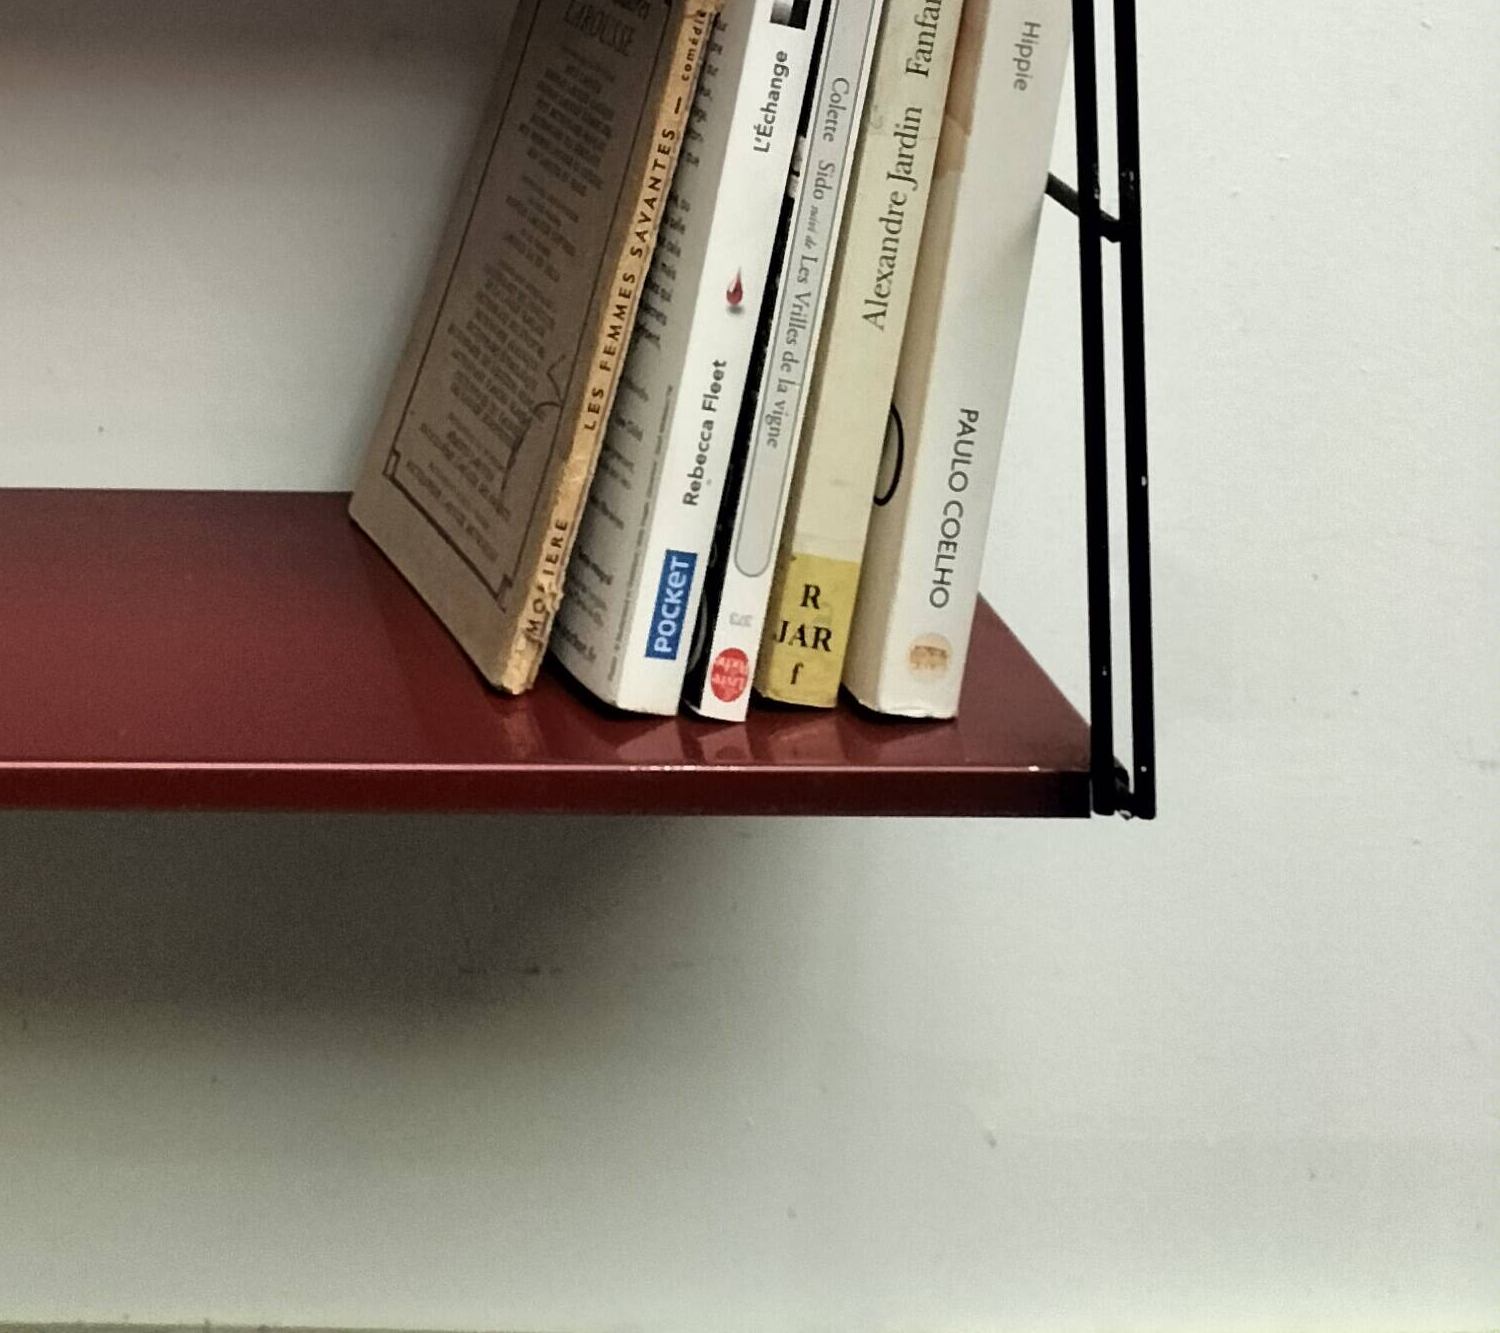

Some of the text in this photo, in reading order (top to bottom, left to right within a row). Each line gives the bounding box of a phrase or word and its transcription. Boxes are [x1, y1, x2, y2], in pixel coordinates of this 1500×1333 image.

[1012, 19, 1043, 92] Hippie
[752, 49, 791, 154] L'Échange
[822, 76, 851, 144] Colette
[812, 159, 837, 201] Sido
[861, 105, 924, 333] Alexandre Jardin
[583, 386, 605, 432] LES
[598, 271, 636, 373] FEMMES
[629, 127, 677, 260] SAVANTES
[796, 251, 819, 286] Les
[785, 286, 813, 353] Vrilles
[775, 377, 797, 397] la
[779, 350, 801, 373] de
[682, 359, 729, 507] Rebecca Fleet
[766, 399, 788, 450] vigne
[928, 407, 980, 610] PAULO COELHO
[799, 583, 823, 611] R
[773, 619, 834, 654] JAR
[788, 662, 805, 686] f
